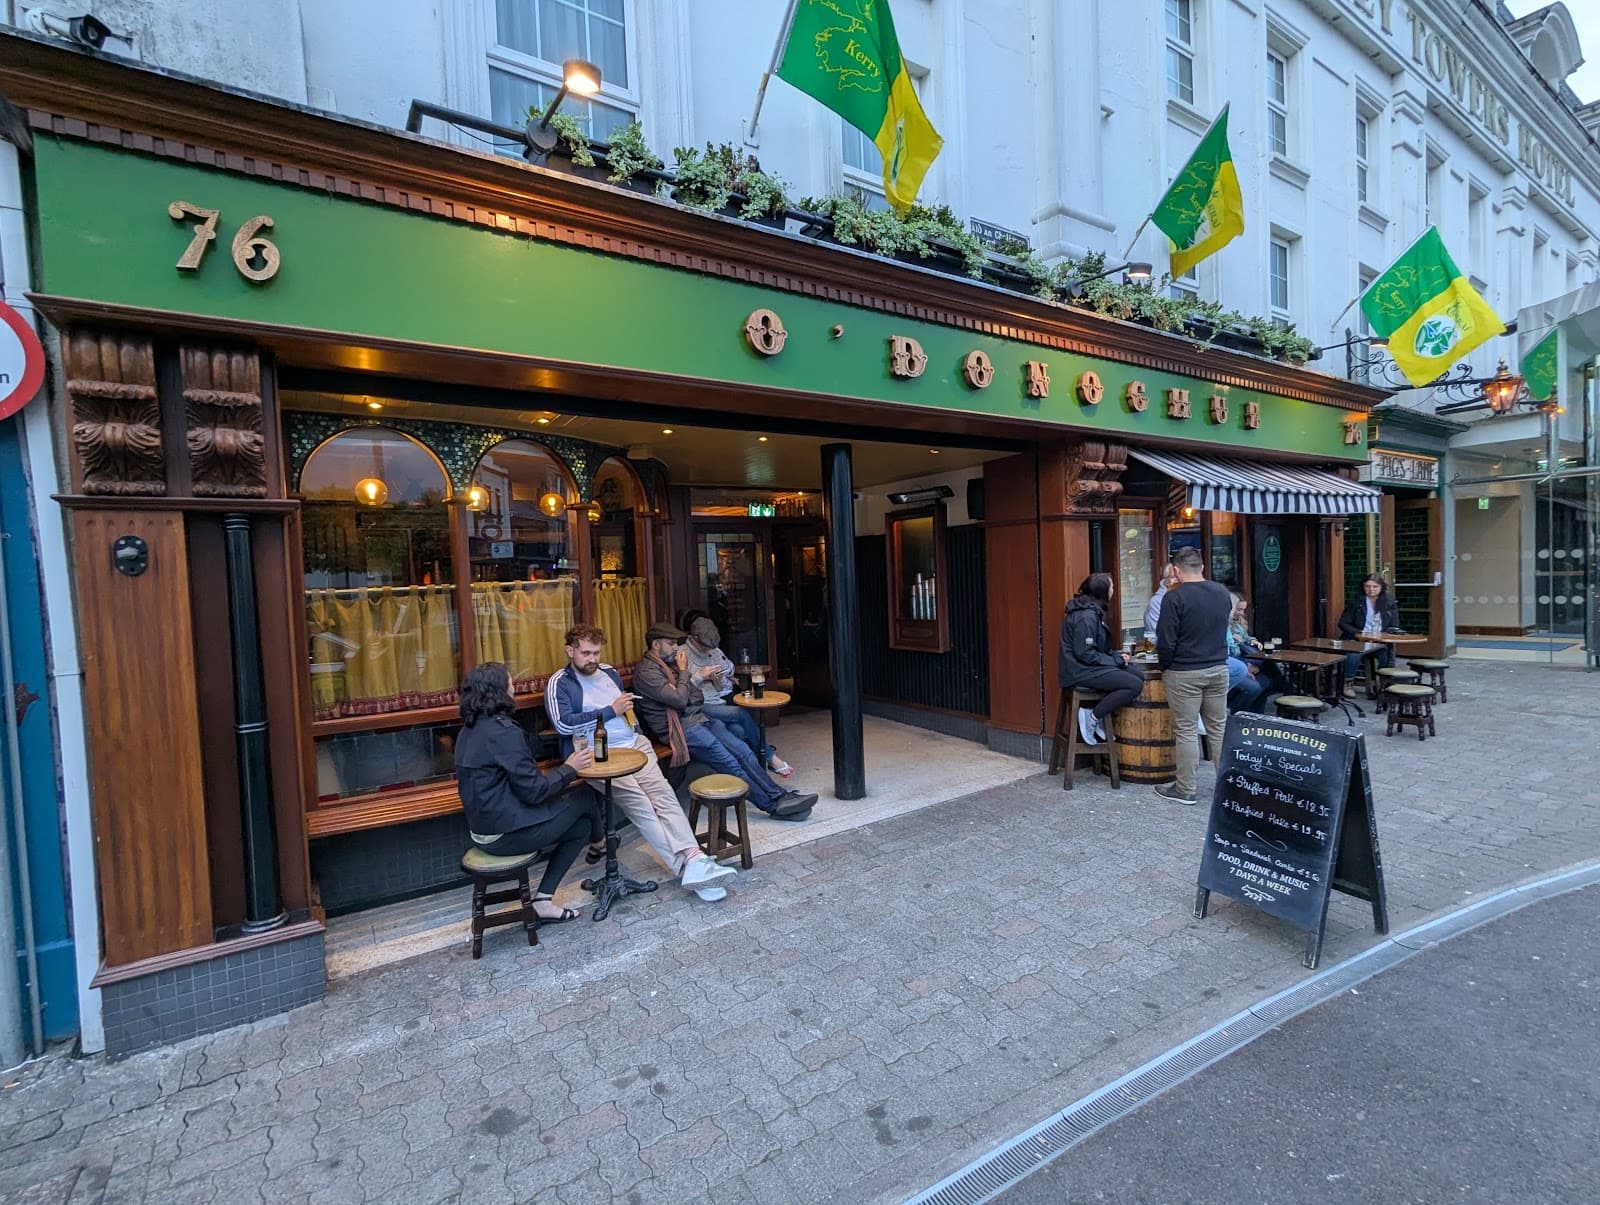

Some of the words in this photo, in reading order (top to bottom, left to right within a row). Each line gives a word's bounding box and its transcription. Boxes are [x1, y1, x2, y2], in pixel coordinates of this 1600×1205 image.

[843, 39, 881, 78] Kerry
[1406, 8, 1509, 146] TOWERS
[1518, 122, 1575, 208] HOTEL
[167, 199, 281, 285] 76
[1344, 422, 1362, 445] 76
[1232, 748, 1273, 768] Today's
[1278, 756, 1322, 776] Specials
[1263, 743, 1283, 753] PUBLIC
[1283, 747, 1302, 756] HOUSE
[1236, 775, 1270, 796] Stuffed
[1235, 868, 1257, 883] DAYS
[1257, 877, 1264, 886] A
[1267, 880, 1292, 896] WEEK
[1243, 860, 1271, 877] DRINK
[1271, 871, 1278, 880] &
[1280, 874, 1310, 891] MUSIC
